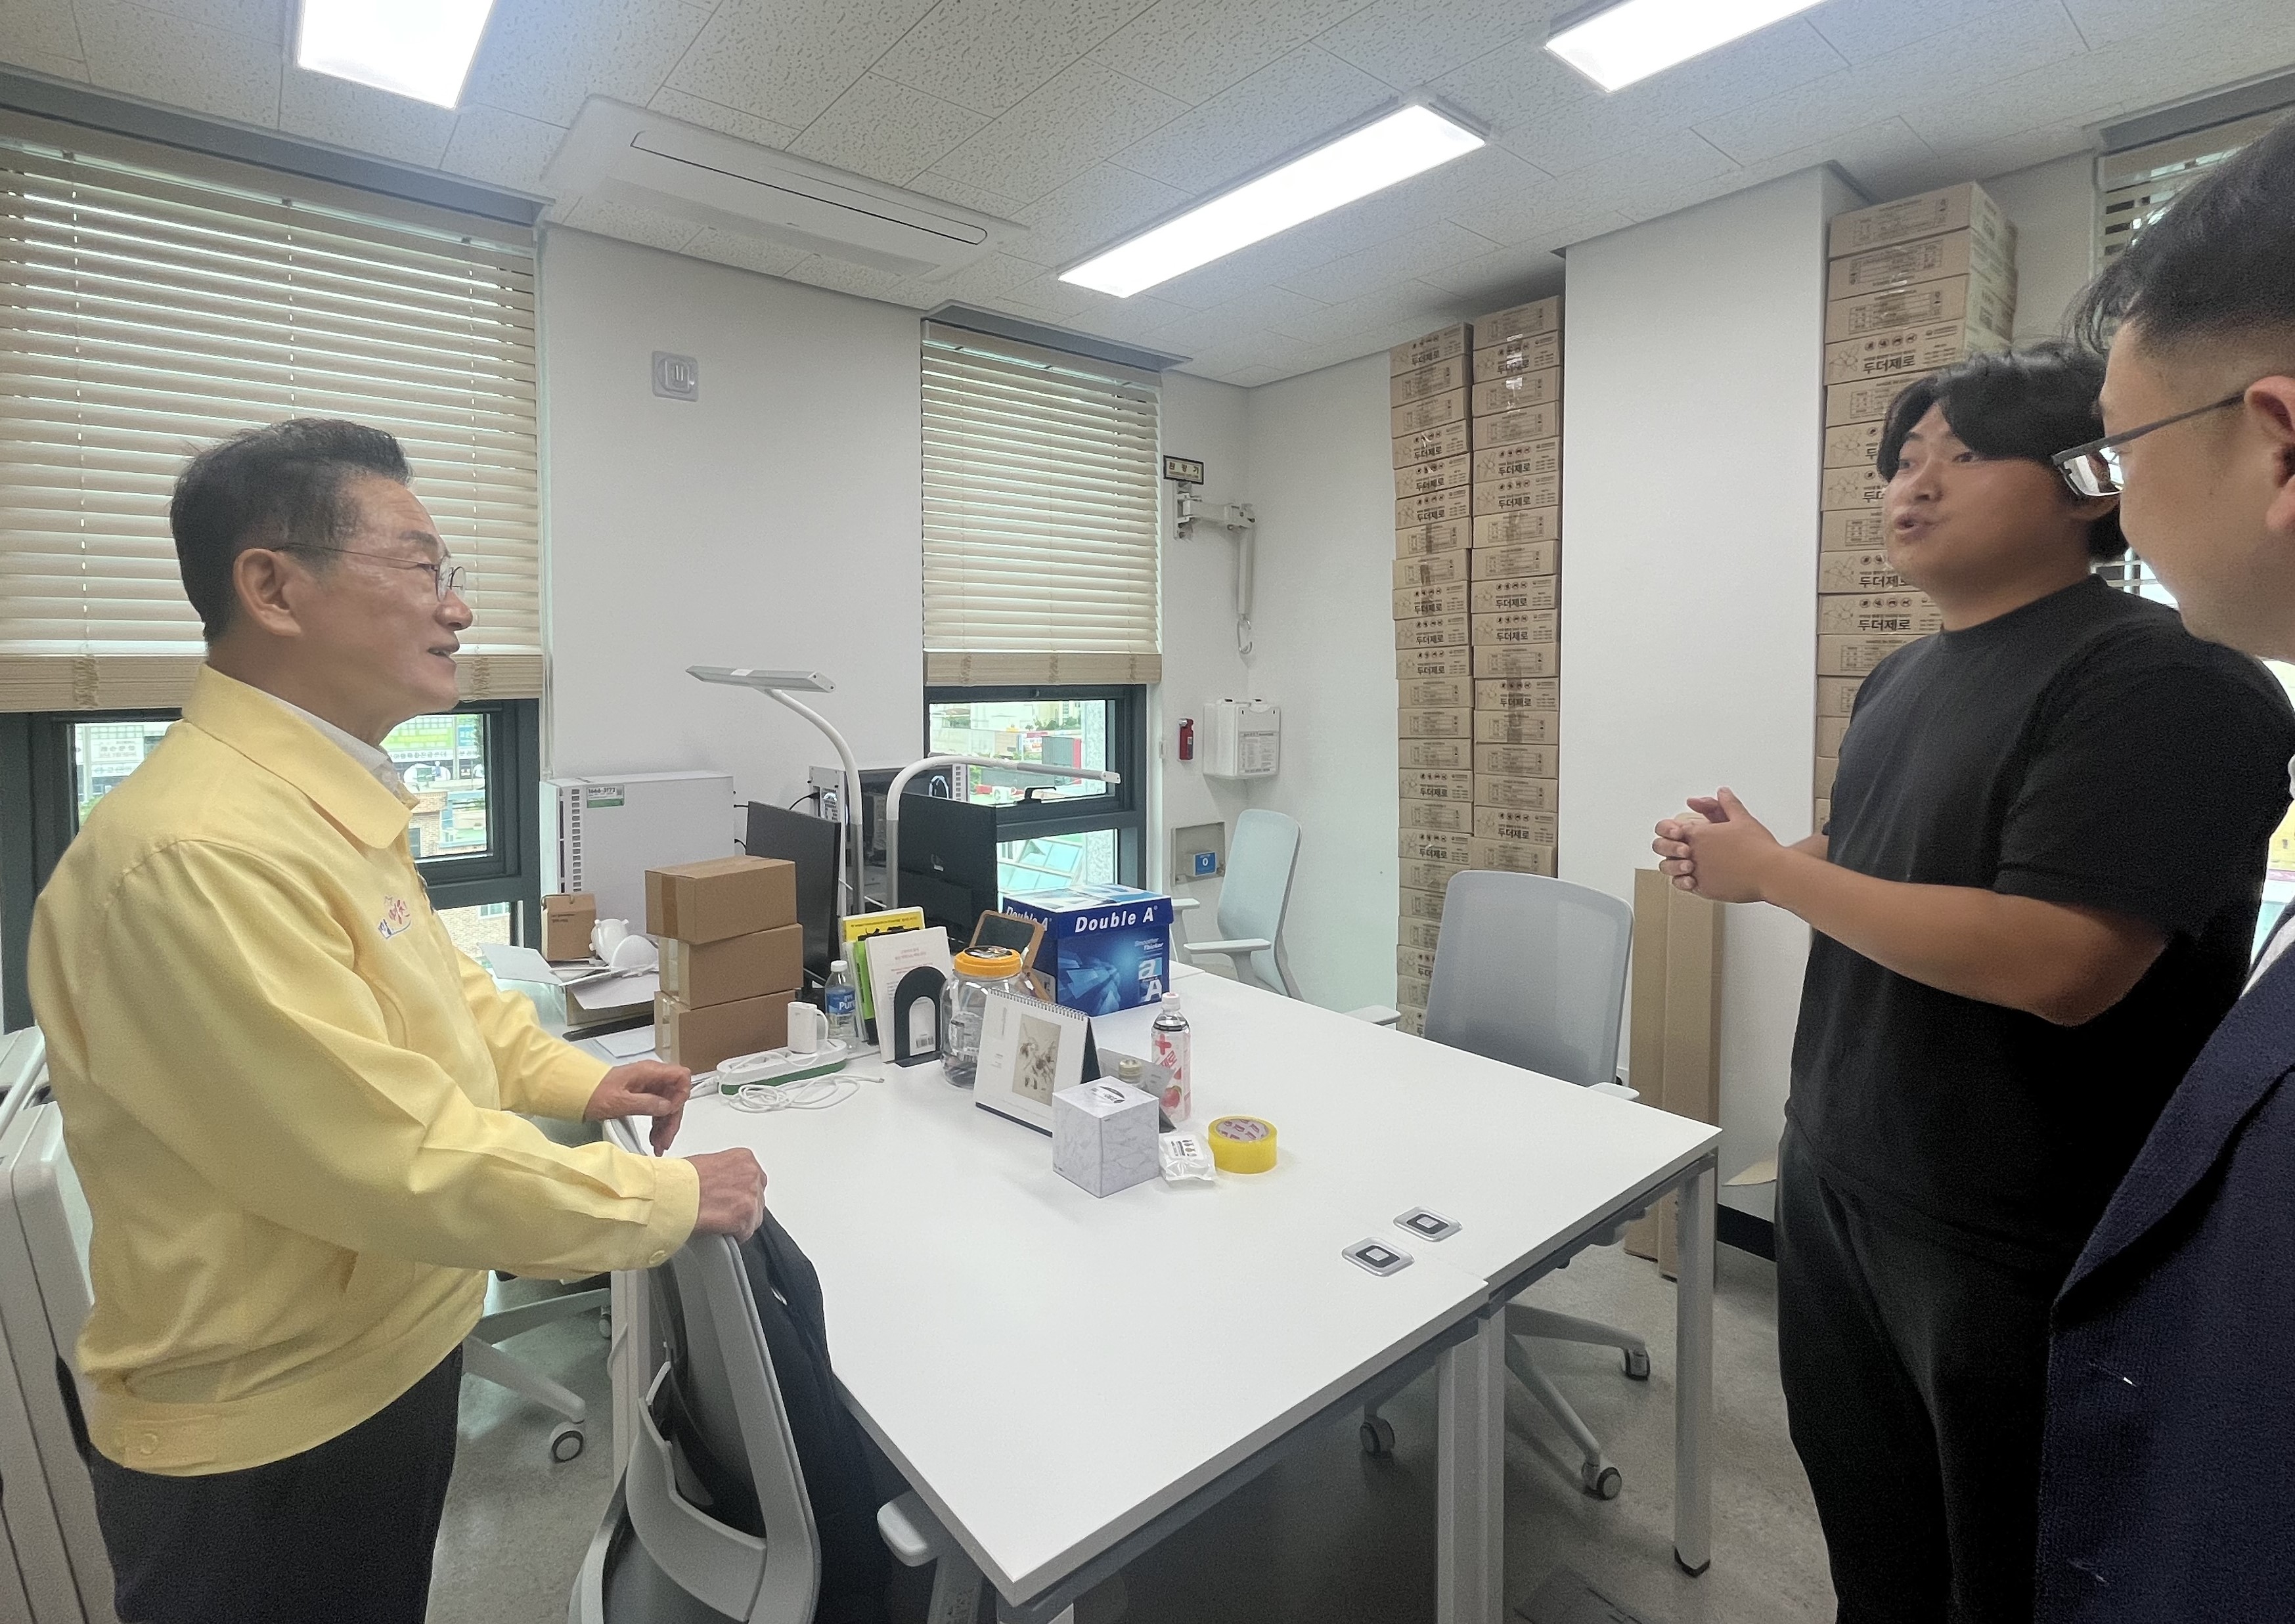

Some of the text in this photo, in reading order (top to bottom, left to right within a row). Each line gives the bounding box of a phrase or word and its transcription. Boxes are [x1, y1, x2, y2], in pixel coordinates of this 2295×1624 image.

[1863, 355, 1916, 374] 두더제로
[1498, 462, 1531, 475] 두더제로
[1498, 496, 1531, 508] 두더제로
[1496, 598, 1528, 608] 두더제로
[1858, 619, 1911, 631] 두더제로
[1416, 634, 1444, 645] 두더제로
[1496, 631, 1528, 642] 두더제로
[1417, 665, 1445, 675] 두더제로
[1498, 828, 1530, 839] 두더제로
[1075, 907, 1154, 933] Double A
[1418, 968, 1433, 978] 두더
